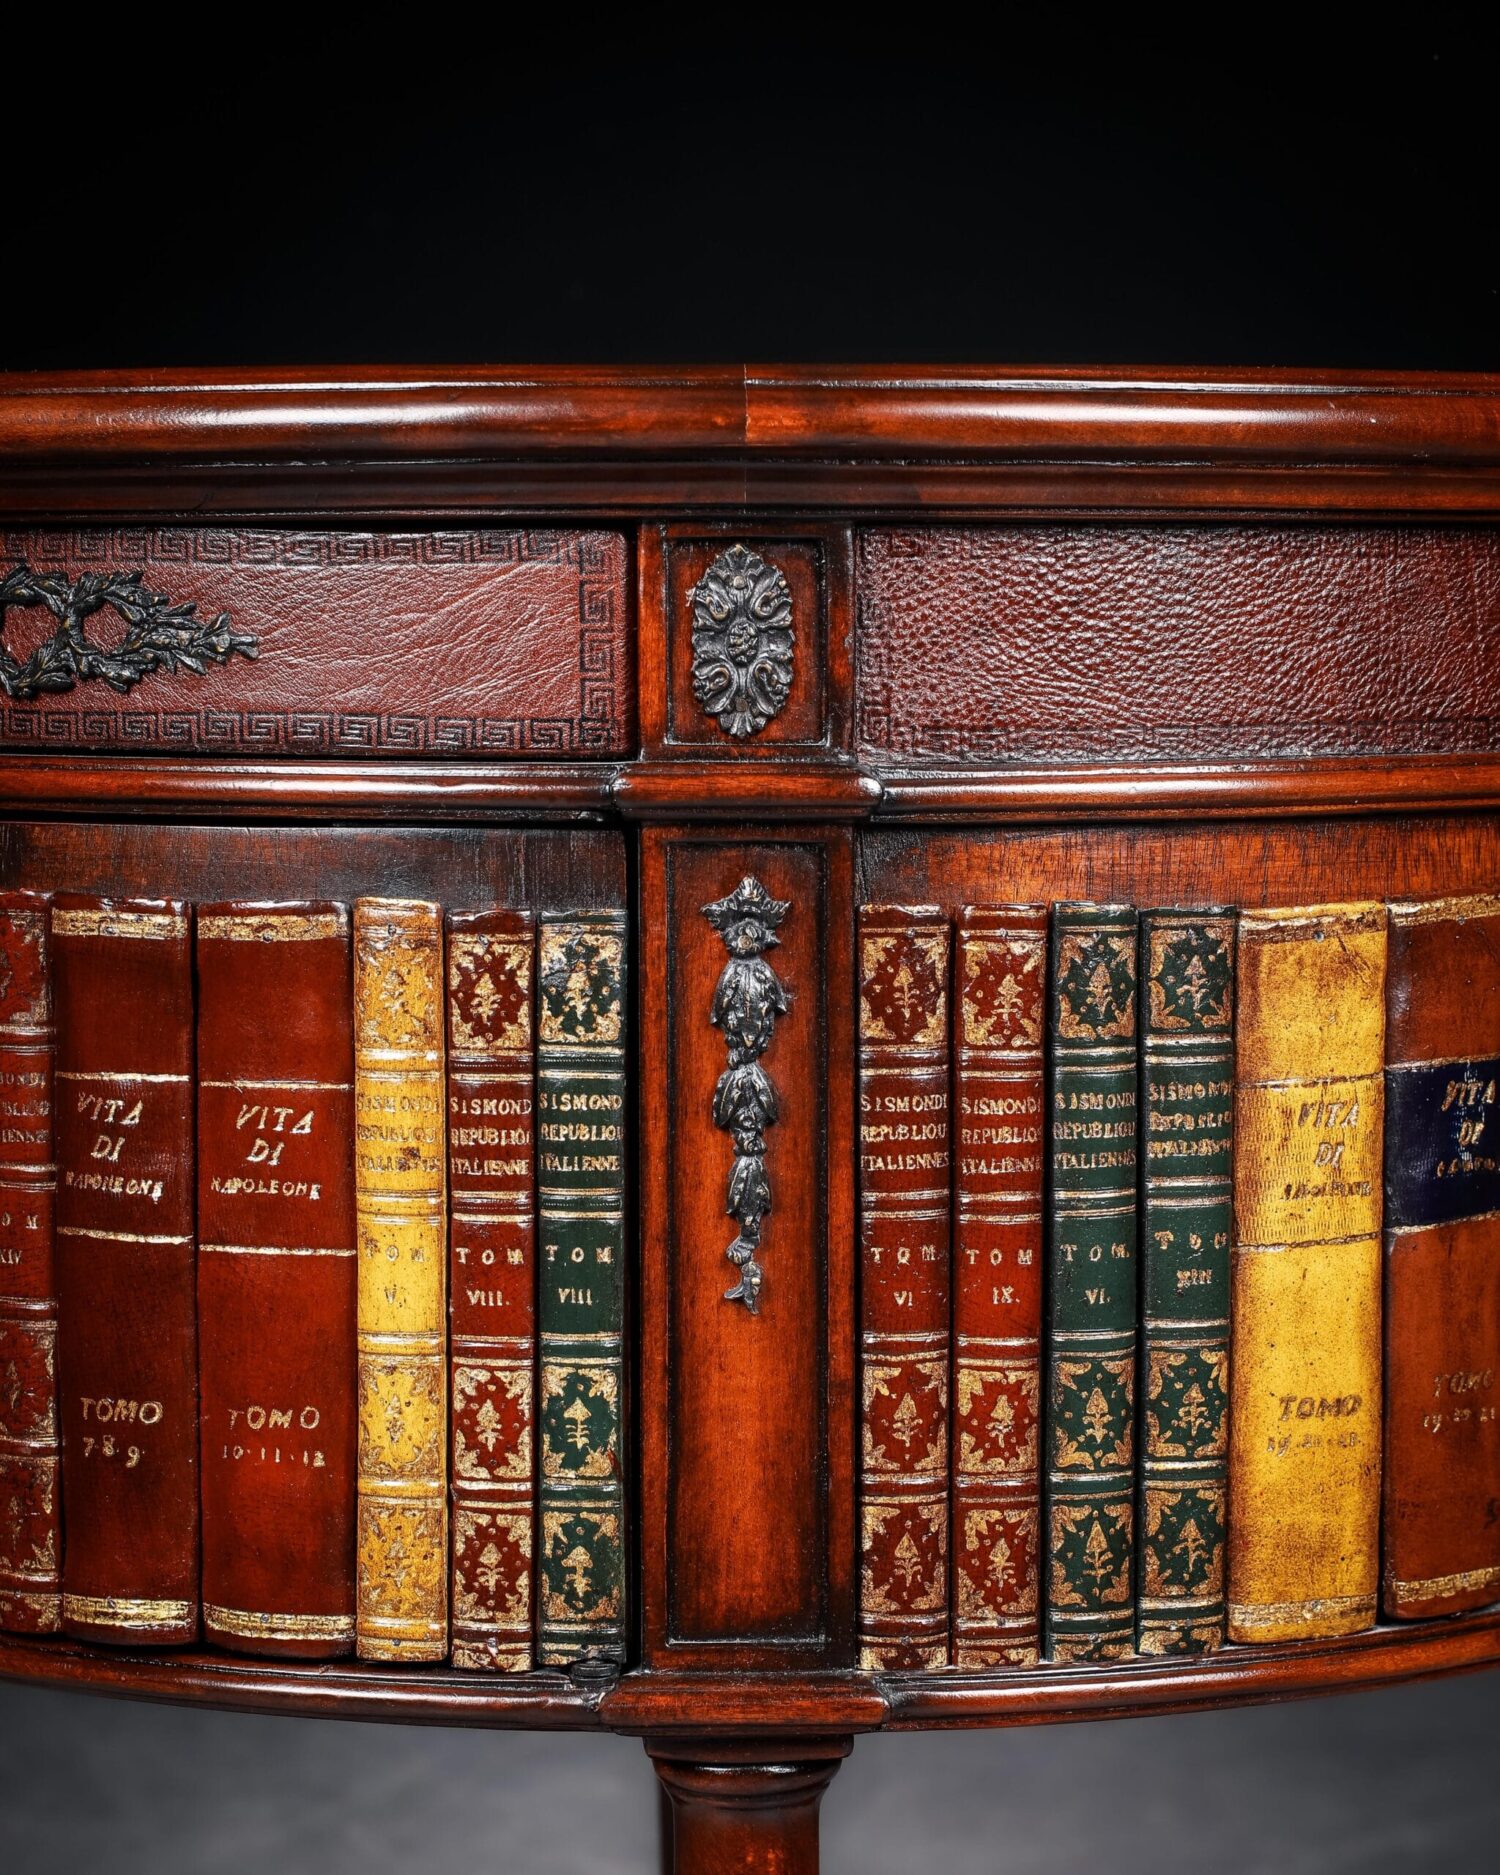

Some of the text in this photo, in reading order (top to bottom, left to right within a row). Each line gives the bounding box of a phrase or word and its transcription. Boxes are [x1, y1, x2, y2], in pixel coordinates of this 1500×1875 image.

[77, 1091, 143, 1126] VITA
[861, 1093, 947, 1112] SISMONDI
[1441, 1079, 1496, 1112] VITA
[236, 1104, 314, 1134] VITA
[1297, 1100, 1359, 1128] VITA
[1458, 1120, 1485, 1145] DI
[90, 1135, 125, 1162] DI
[245, 1138, 285, 1166] DI
[1313, 1141, 1345, 1168] DI
[455, 1247, 524, 1265] TOM
[966, 1248, 1033, 1266] TOM
[80, 1397, 164, 1424] TOMO
[227, 1405, 321, 1430] TOMO
[1279, 1394, 1363, 1421] TOMO
